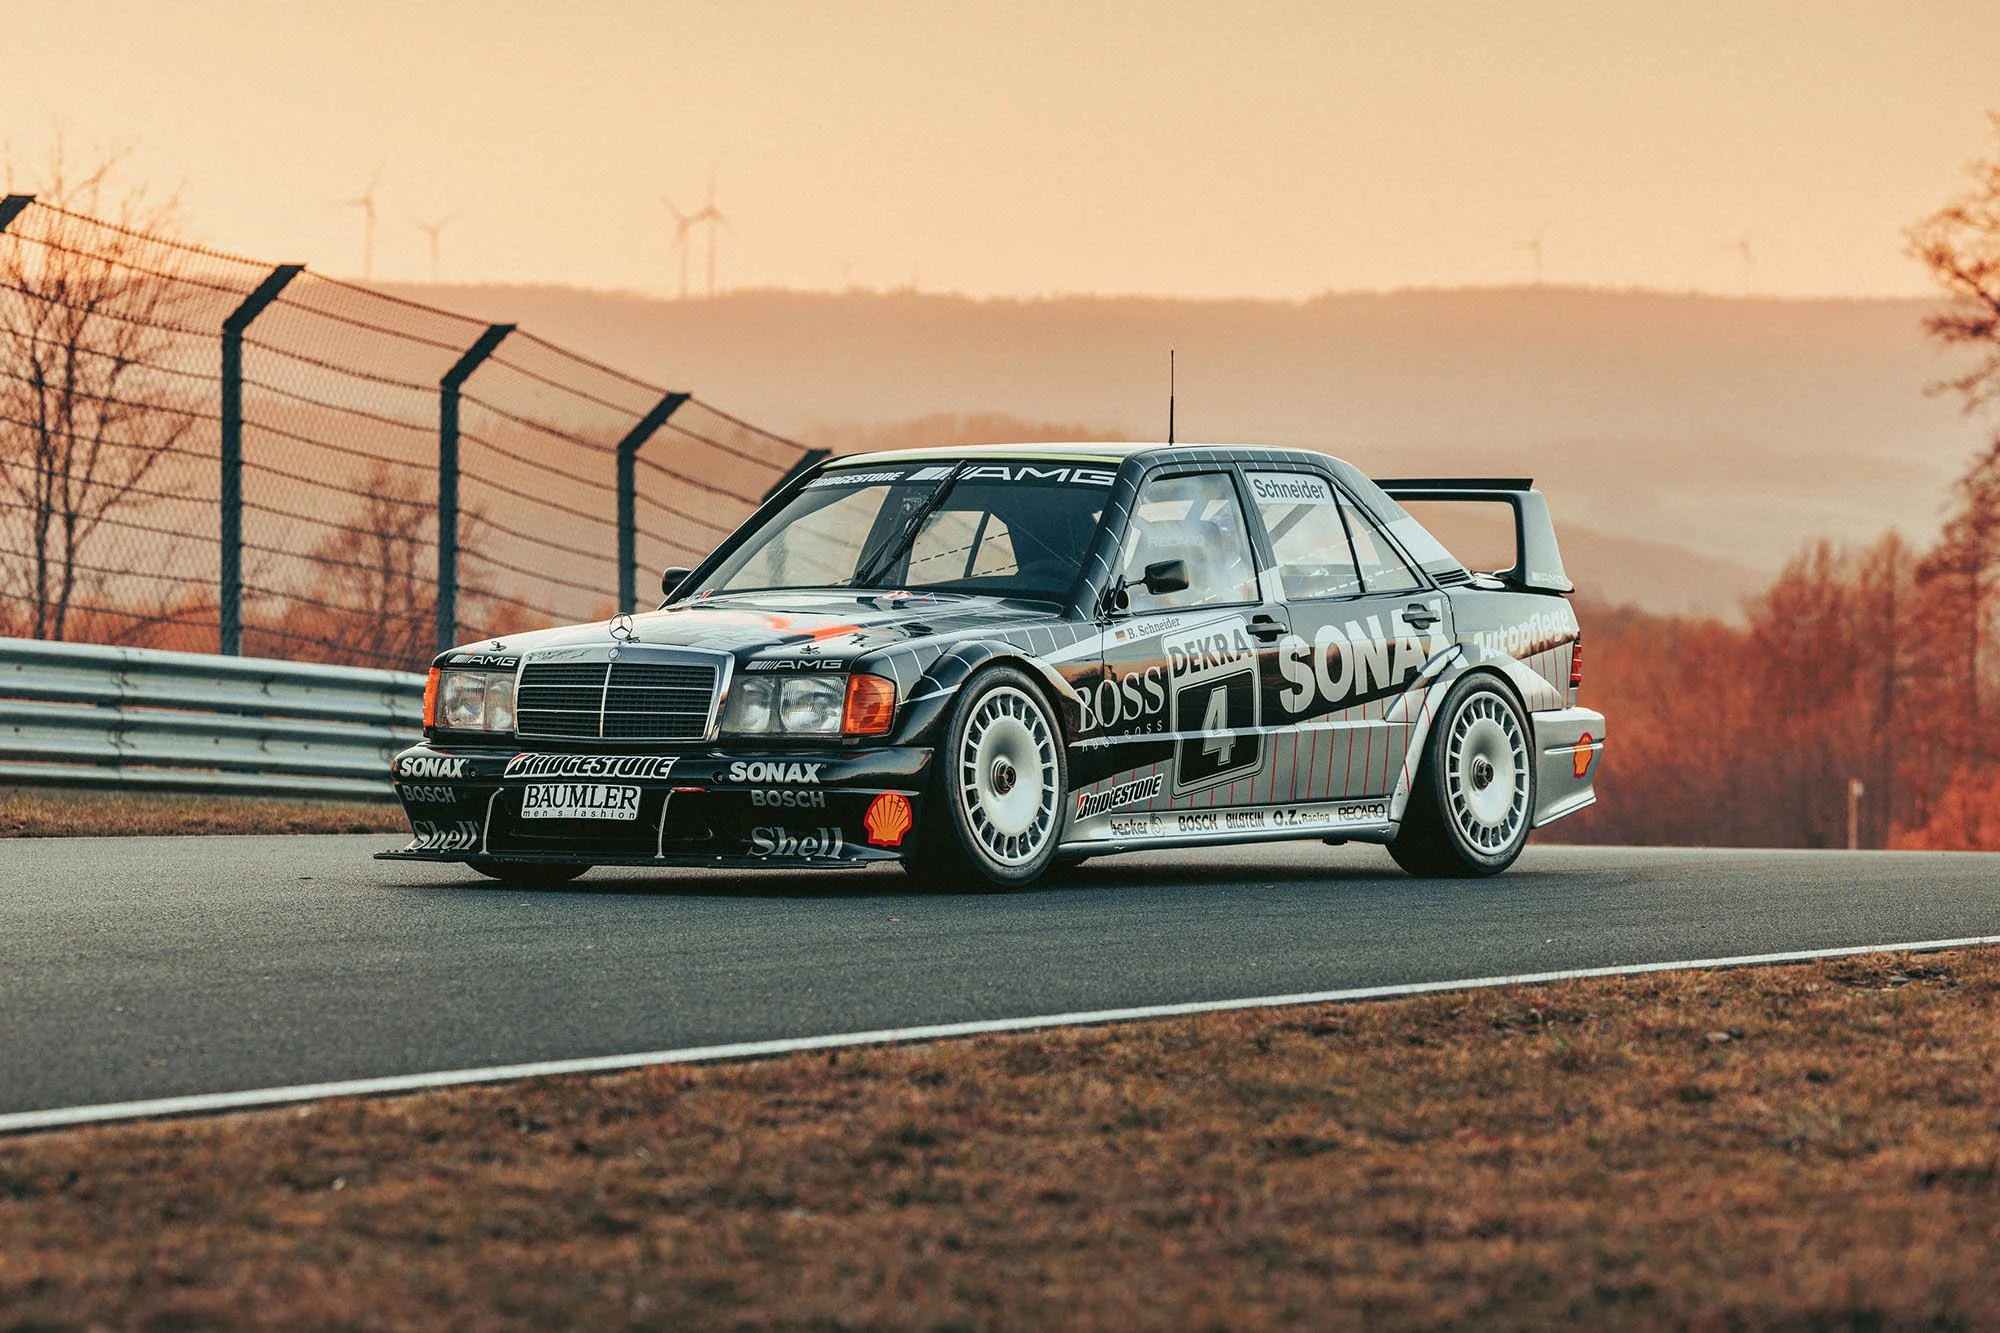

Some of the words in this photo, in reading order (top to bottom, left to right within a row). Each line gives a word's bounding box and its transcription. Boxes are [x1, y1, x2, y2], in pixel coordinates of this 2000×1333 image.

[962, 466, 1117, 487] AMG
[1253, 478, 1325, 499] Schneider
[1127, 628, 1138, 640] B.
[1139, 616, 1182, 636] Schneider
[467, 655, 518, 666] AMG
[773, 659, 843, 670] AMG
[1167, 628, 1253, 678] DEKRA
[1073, 666, 1165, 733] BOSS
[1201, 685, 1236, 766] 4
[400, 757, 466, 778] SONAX
[504, 753, 681, 779] BRIDGESTONE
[729, 761, 822, 783] SONAX
[402, 785, 457, 803] BOSCH
[524, 785, 638, 810] BÄUMLER
[751, 789, 826, 808] BOSCH
[574, 809, 635, 819] fashion
[1110, 818, 1147, 836] becker
[1178, 813, 1218, 832] BOSCH
[1226, 811, 1266, 829] BILSTEIN
[1338, 803, 1386, 822] RECARO
[407, 820, 477, 850] Shell
[747, 826, 844, 859] Shell
